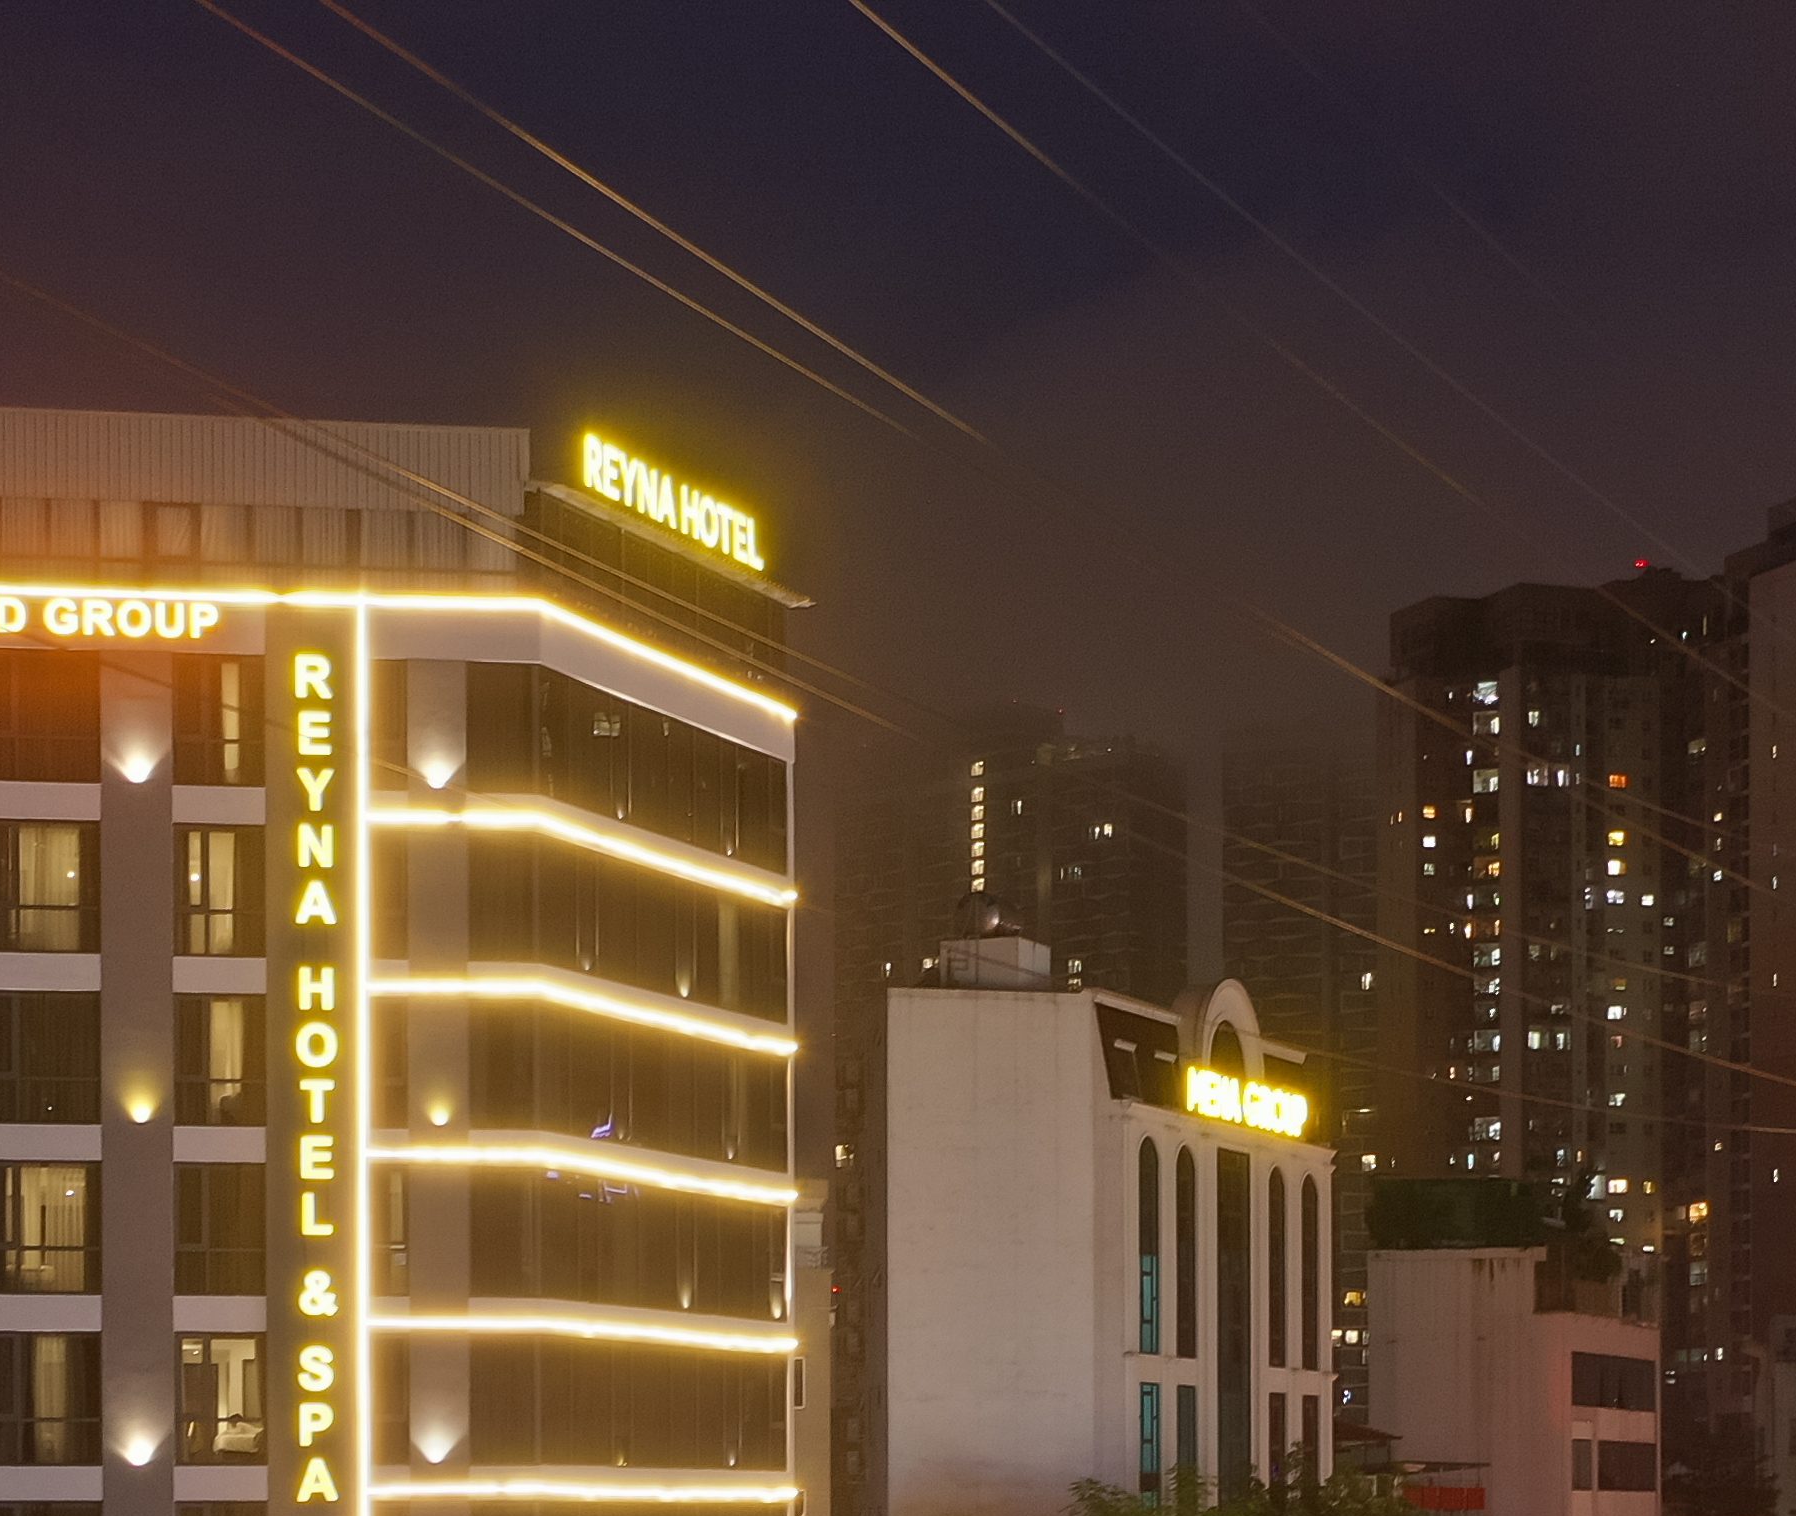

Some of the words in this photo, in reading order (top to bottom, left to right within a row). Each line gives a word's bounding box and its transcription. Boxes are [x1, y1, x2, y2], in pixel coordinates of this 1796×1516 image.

[583, 432, 678, 530] REYNA
[679, 482, 766, 572] HOTEL
[42, 597, 220, 639] GROUP
[293, 653, 338, 926] REYNA
[295, 965, 339, 1236] HOTEL
[1243, 1081, 1309, 1138] GROUP
[297, 1269, 339, 1317] &
[296, 1344, 339, 1503] SPA
